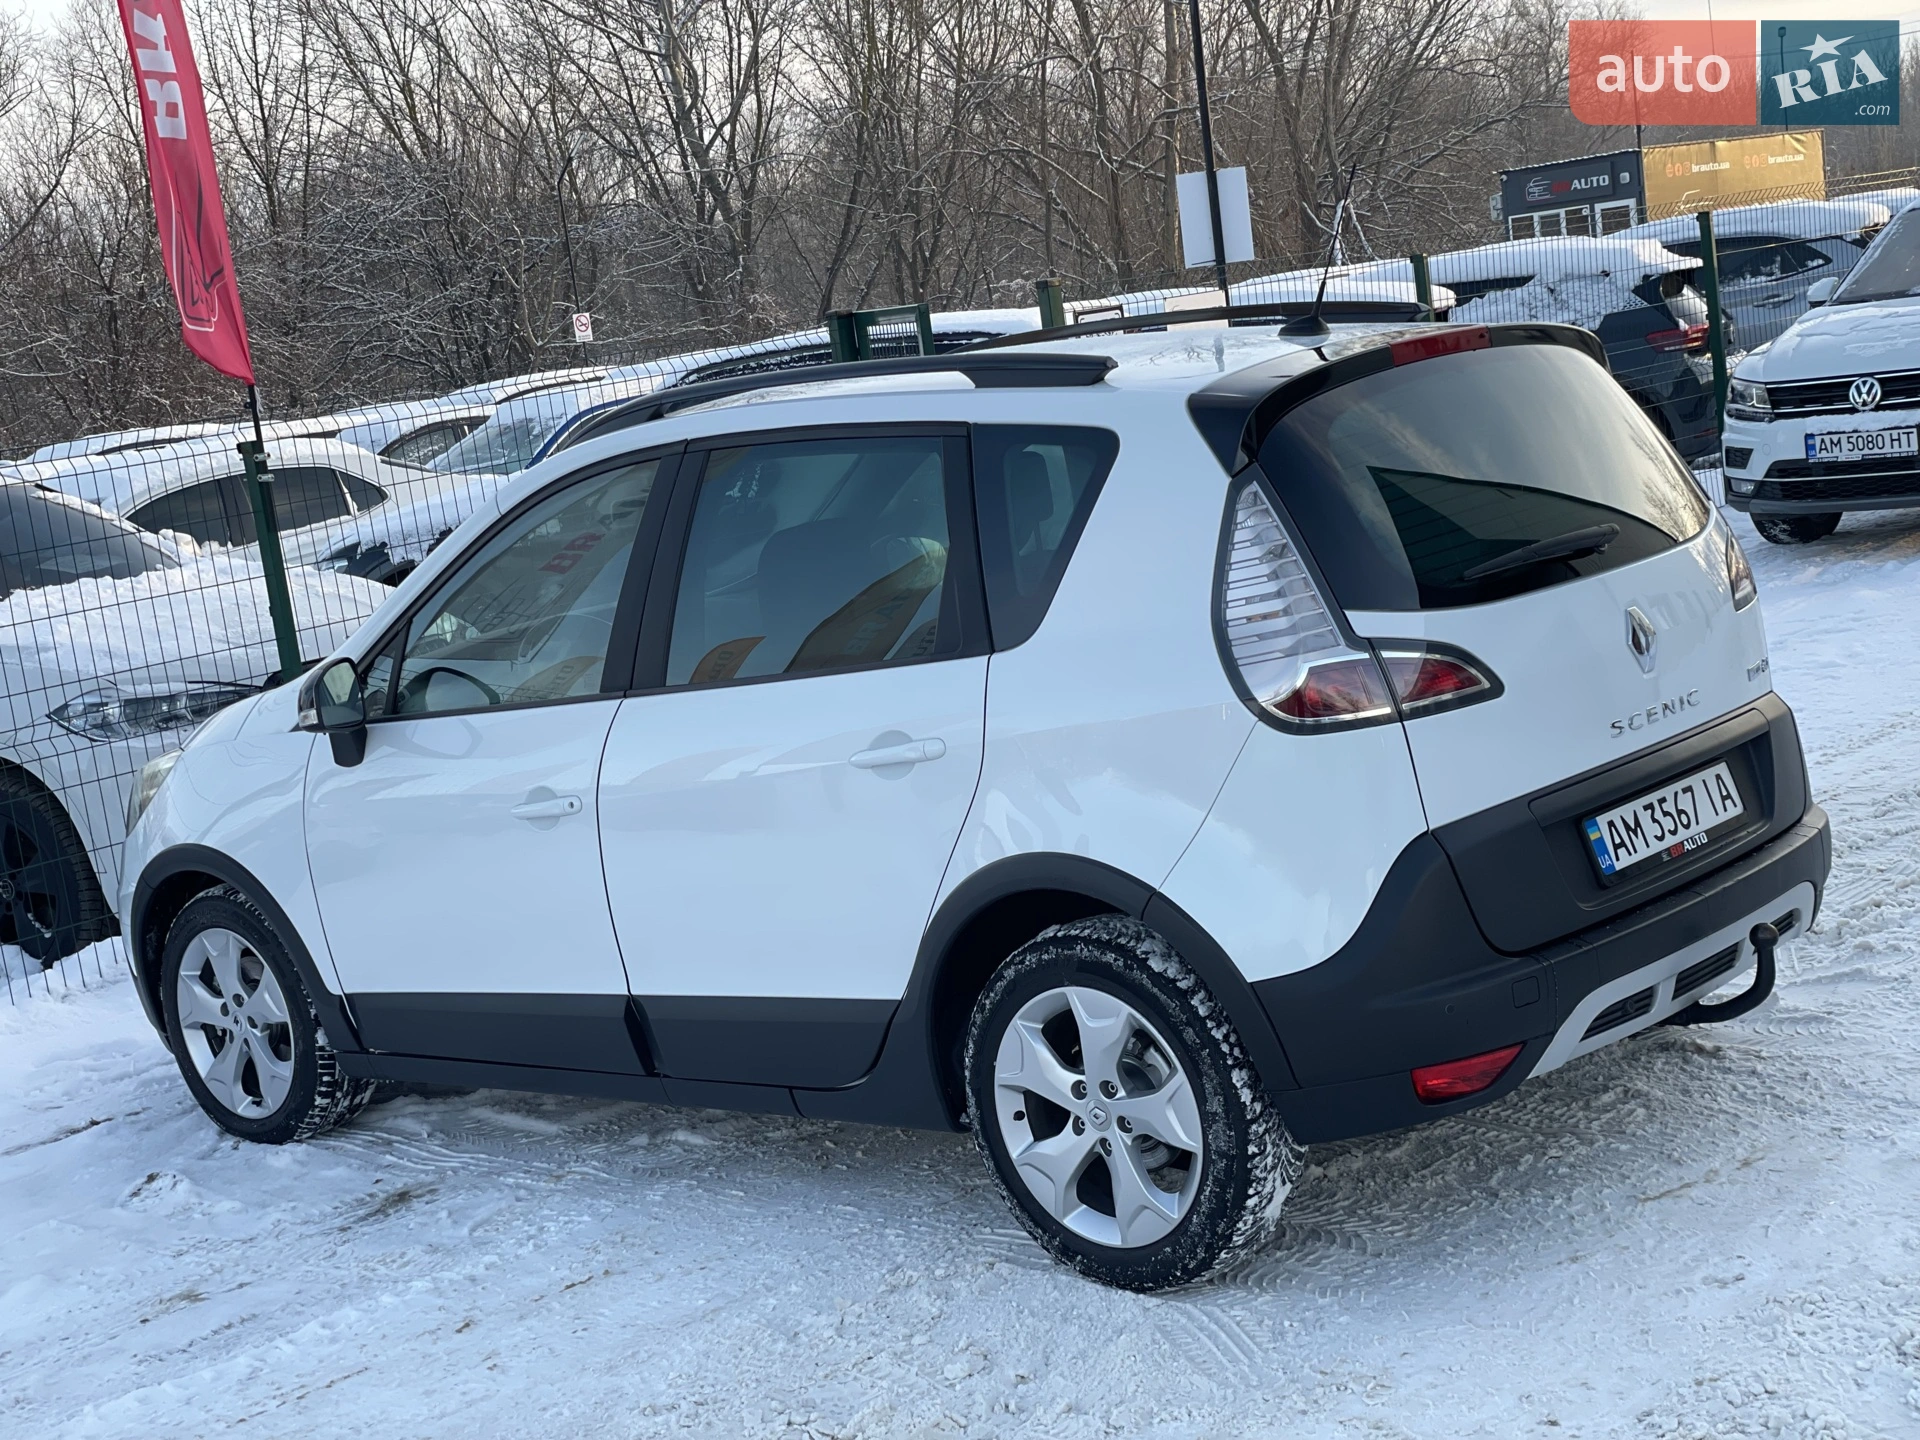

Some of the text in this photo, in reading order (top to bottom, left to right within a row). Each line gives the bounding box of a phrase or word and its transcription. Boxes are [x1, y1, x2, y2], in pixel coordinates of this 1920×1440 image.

[1692, 161, 1730, 173] brauto.ua
[1768, 153, 1804, 164] brauto.ua
[1818, 436, 1843, 455] AM
[1846, 433, 1886, 452] 5080
[1889, 431, 1914, 450] HT
[1610, 688, 1701, 738] SCENIC
[1606, 773, 1738, 862] AM 3567 IA
[1669, 831, 1708, 859] BRAUTO
[1599, 856, 1613, 869] UA
